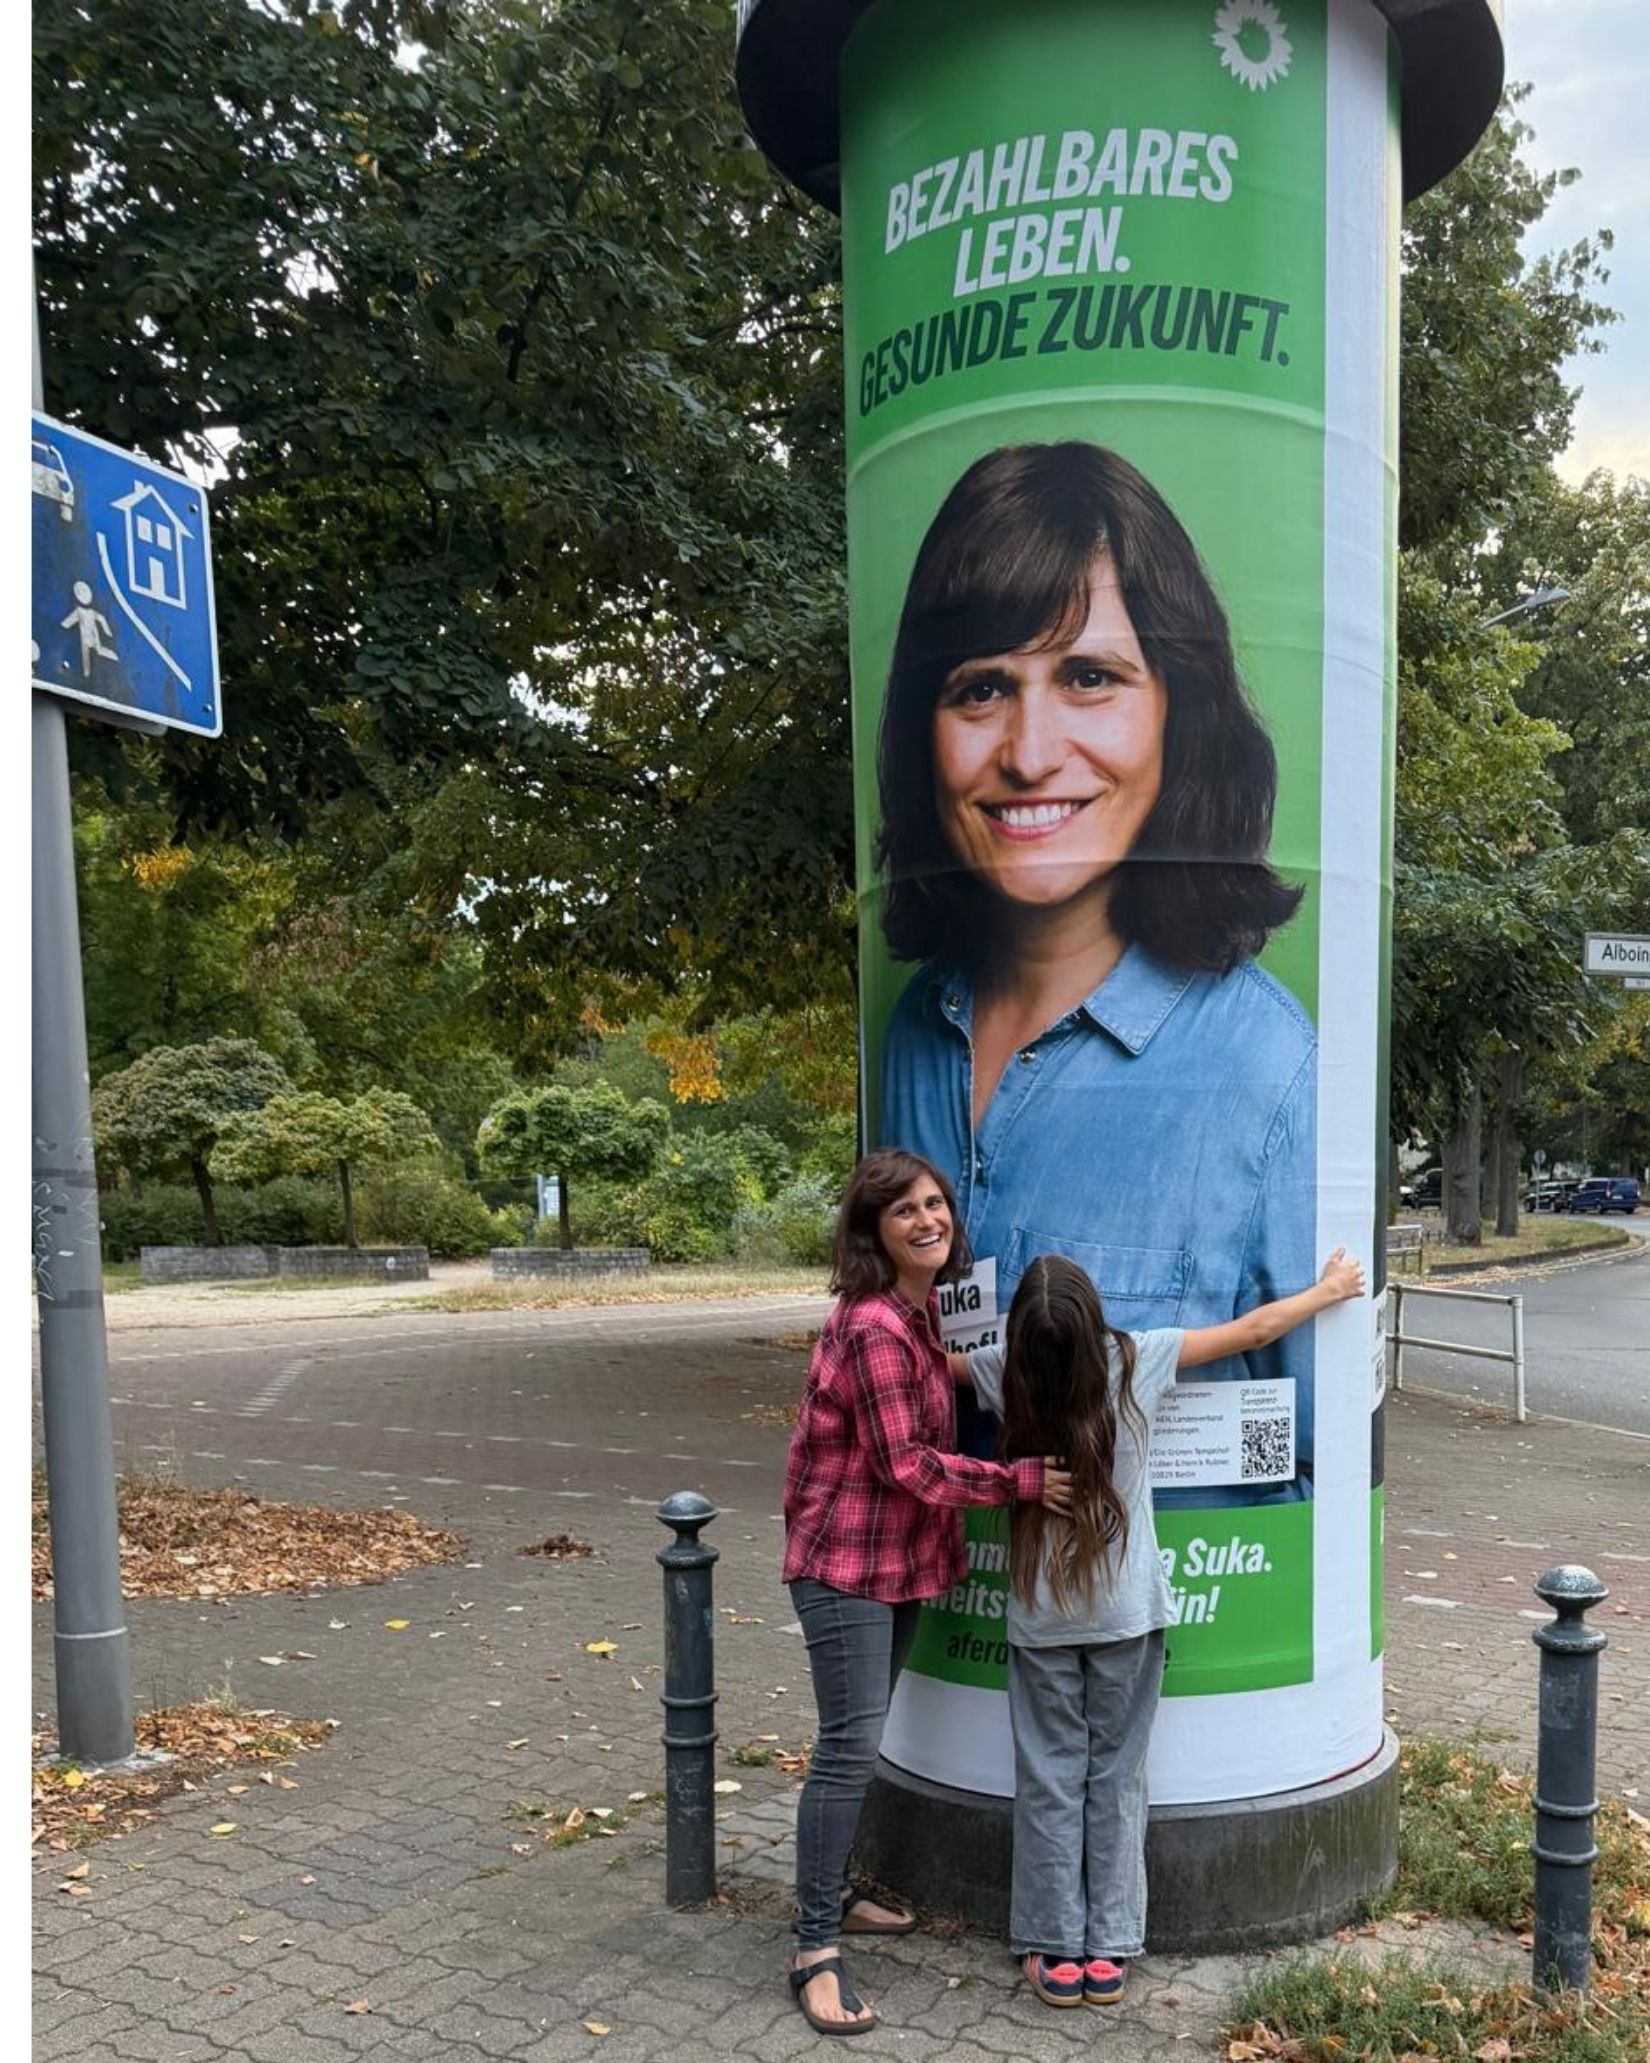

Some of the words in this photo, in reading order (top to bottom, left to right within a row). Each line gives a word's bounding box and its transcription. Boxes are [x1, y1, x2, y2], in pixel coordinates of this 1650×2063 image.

[885, 128, 1238, 254] BEZAHLBARES
[953, 207, 1131, 298] LEBEN.
[859, 291, 1037, 417] GESUNDE
[1038, 284, 1290, 366] ZUKUNFT.
[1183, 1535, 1273, 1577] Suka.
